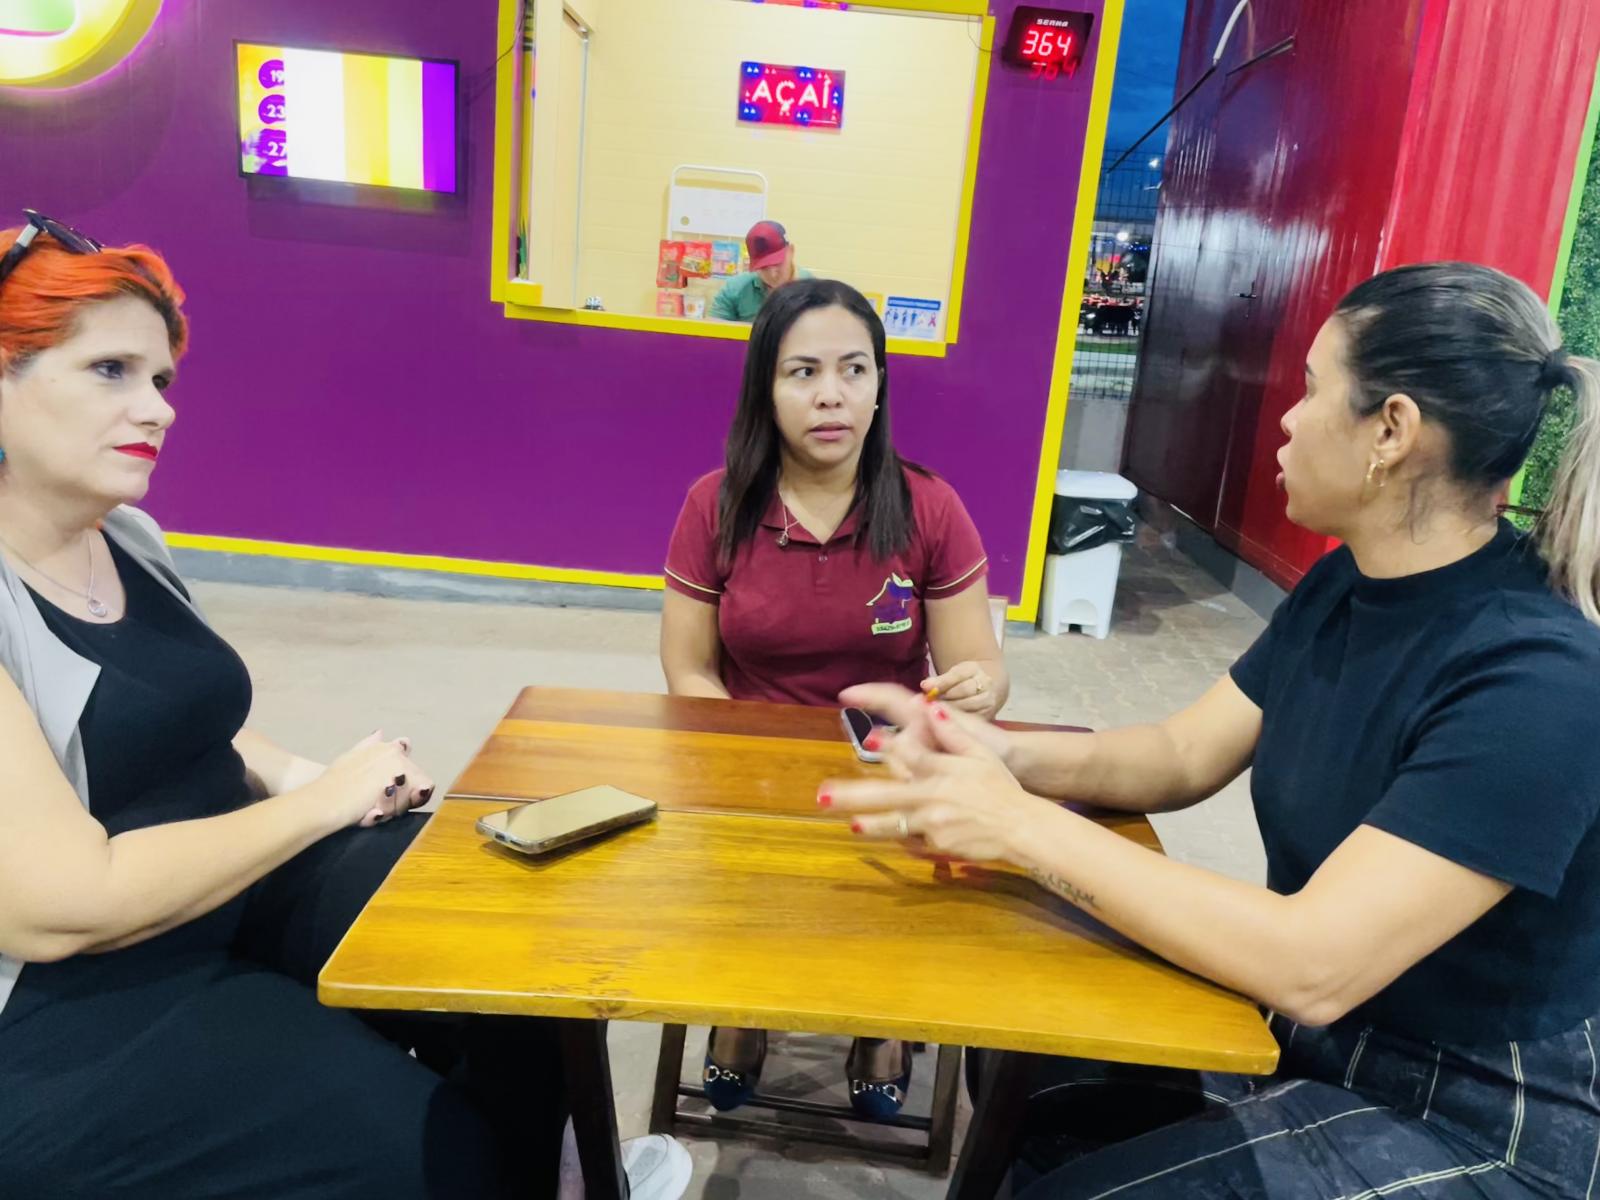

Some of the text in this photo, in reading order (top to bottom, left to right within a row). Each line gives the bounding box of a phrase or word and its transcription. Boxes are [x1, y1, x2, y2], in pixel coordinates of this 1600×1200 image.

[1022, 30, 1071, 56] 364
[266, 103, 286, 118] 23
[267, 141, 287, 156] 27
